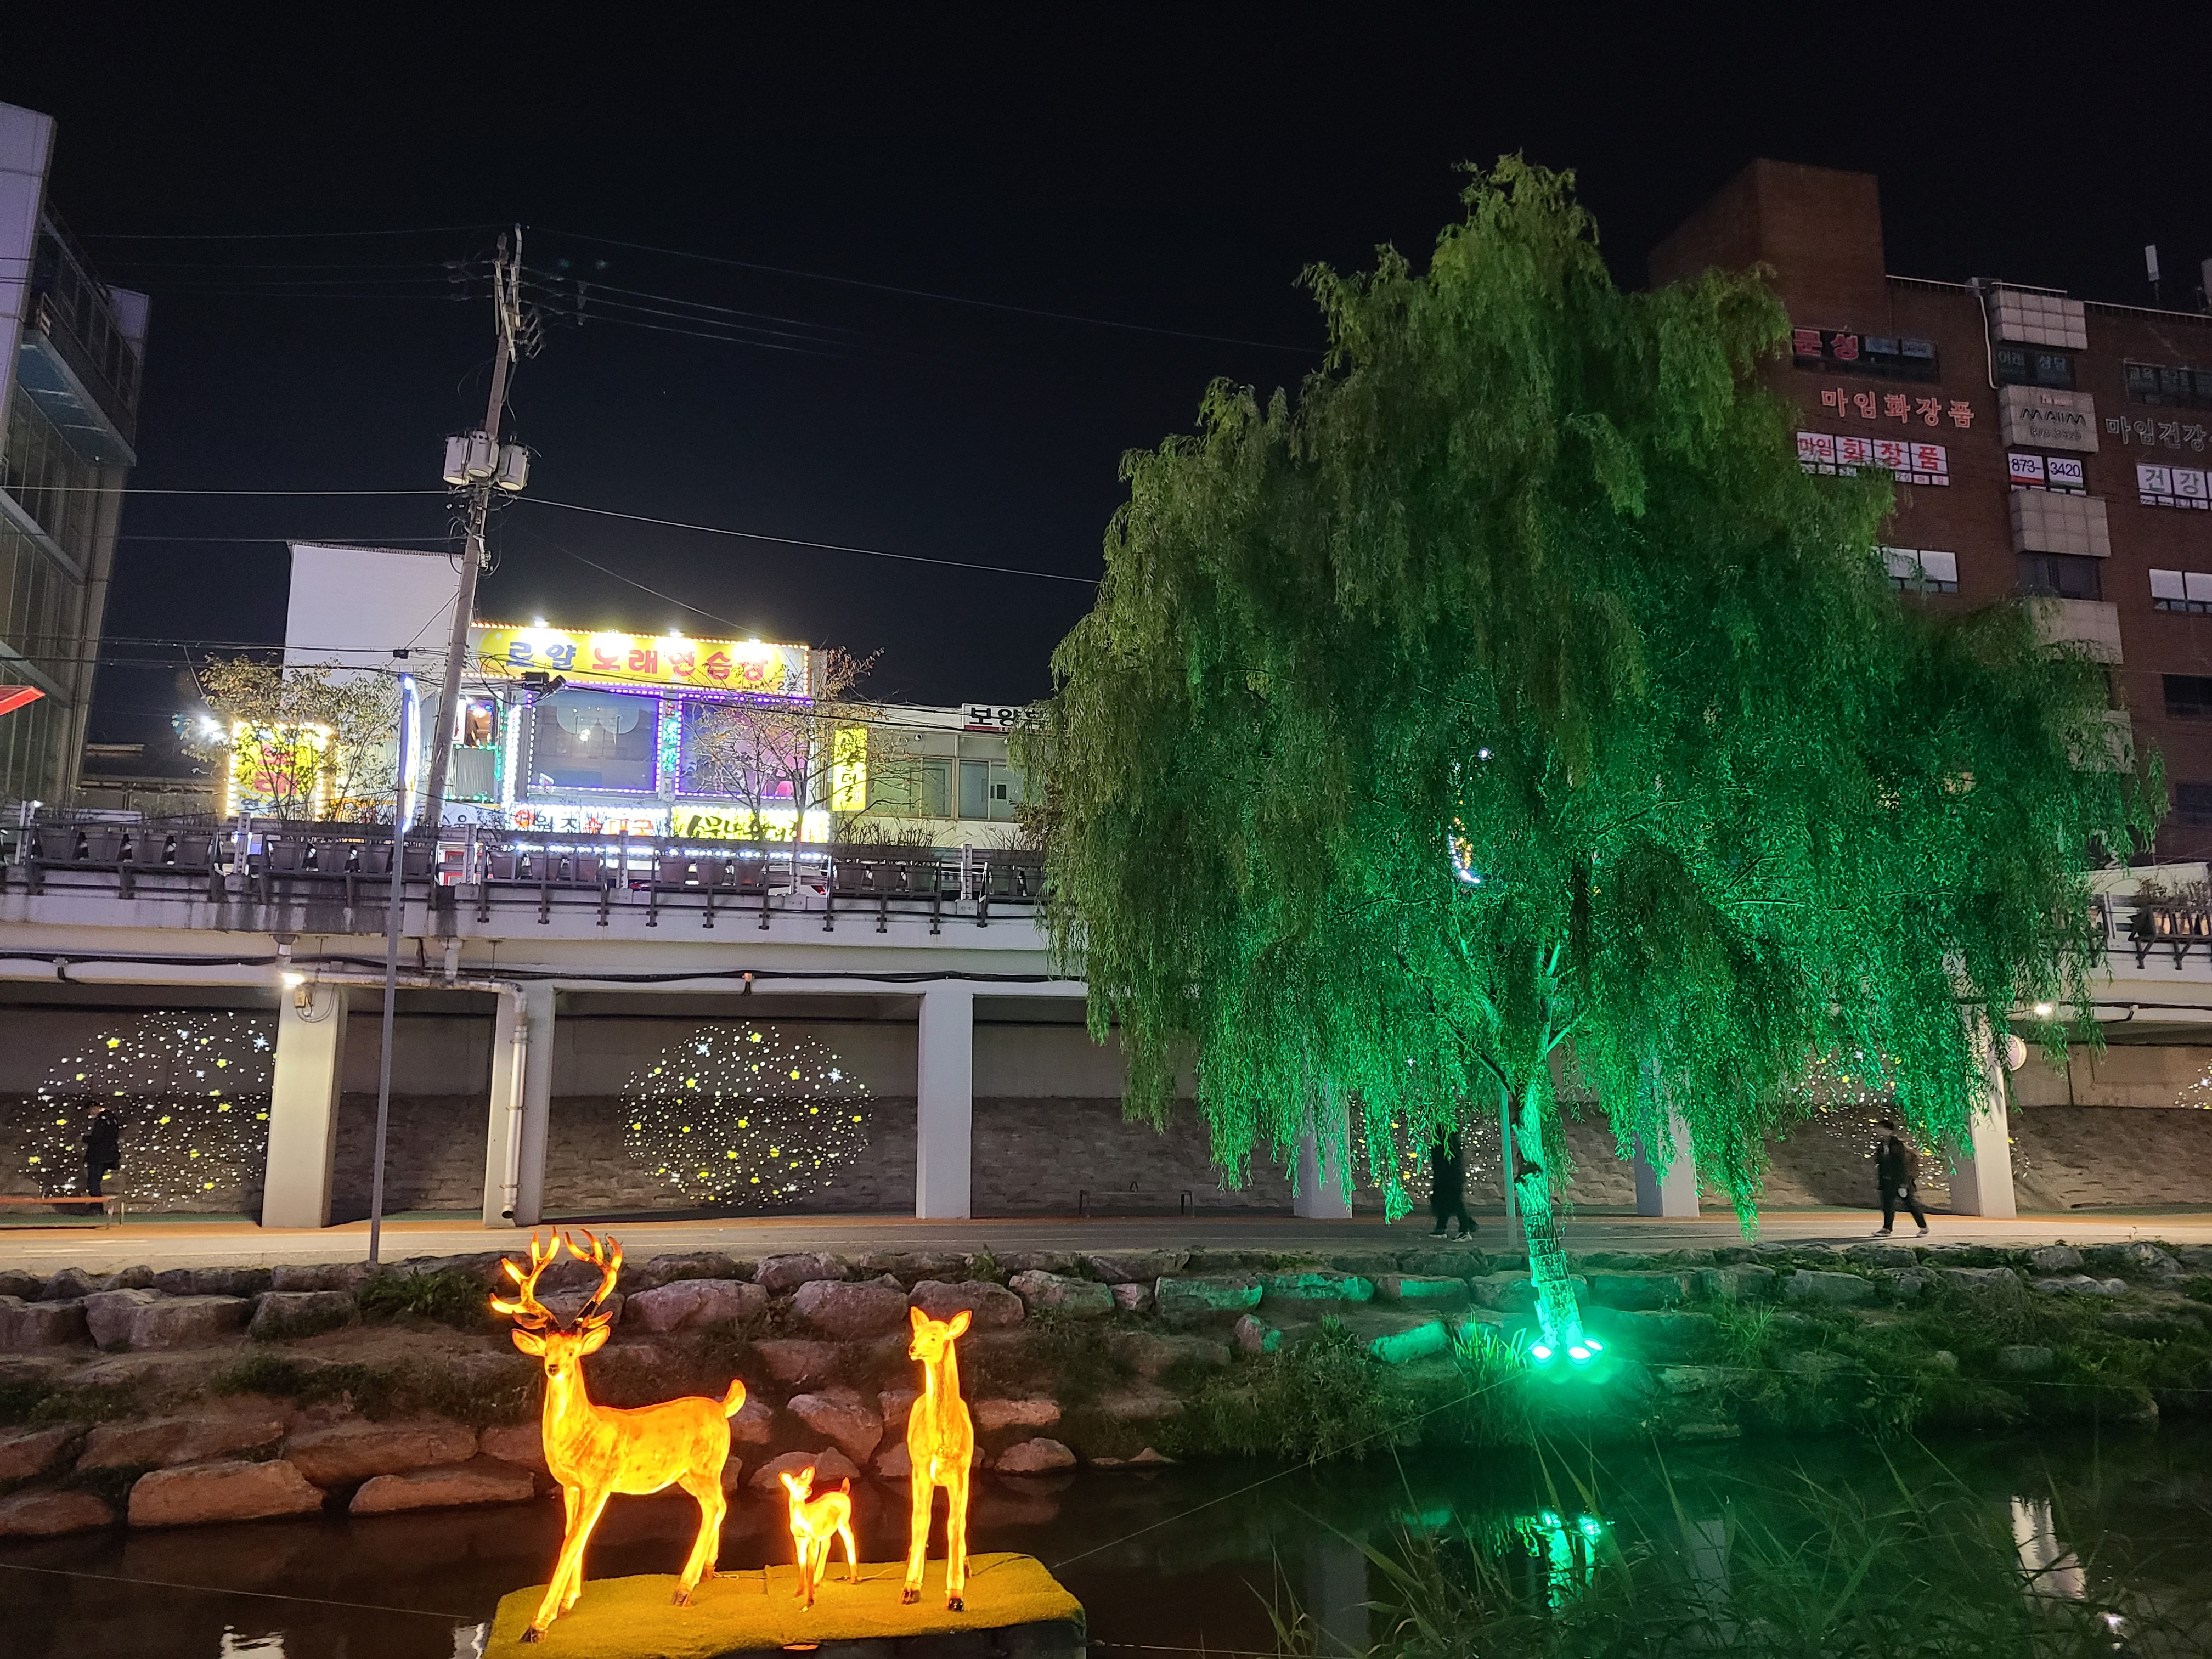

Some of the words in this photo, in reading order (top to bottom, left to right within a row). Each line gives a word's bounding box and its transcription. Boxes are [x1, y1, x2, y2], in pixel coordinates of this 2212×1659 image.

[1821, 387, 1974, 428] 마임화장품
[2105, 416, 2212, 452] 마임건강
[1798, 437, 1940, 471] 마임화장품
[2145, 469, 2199, 495] 건강
[506, 642, 577, 671] 로얄
